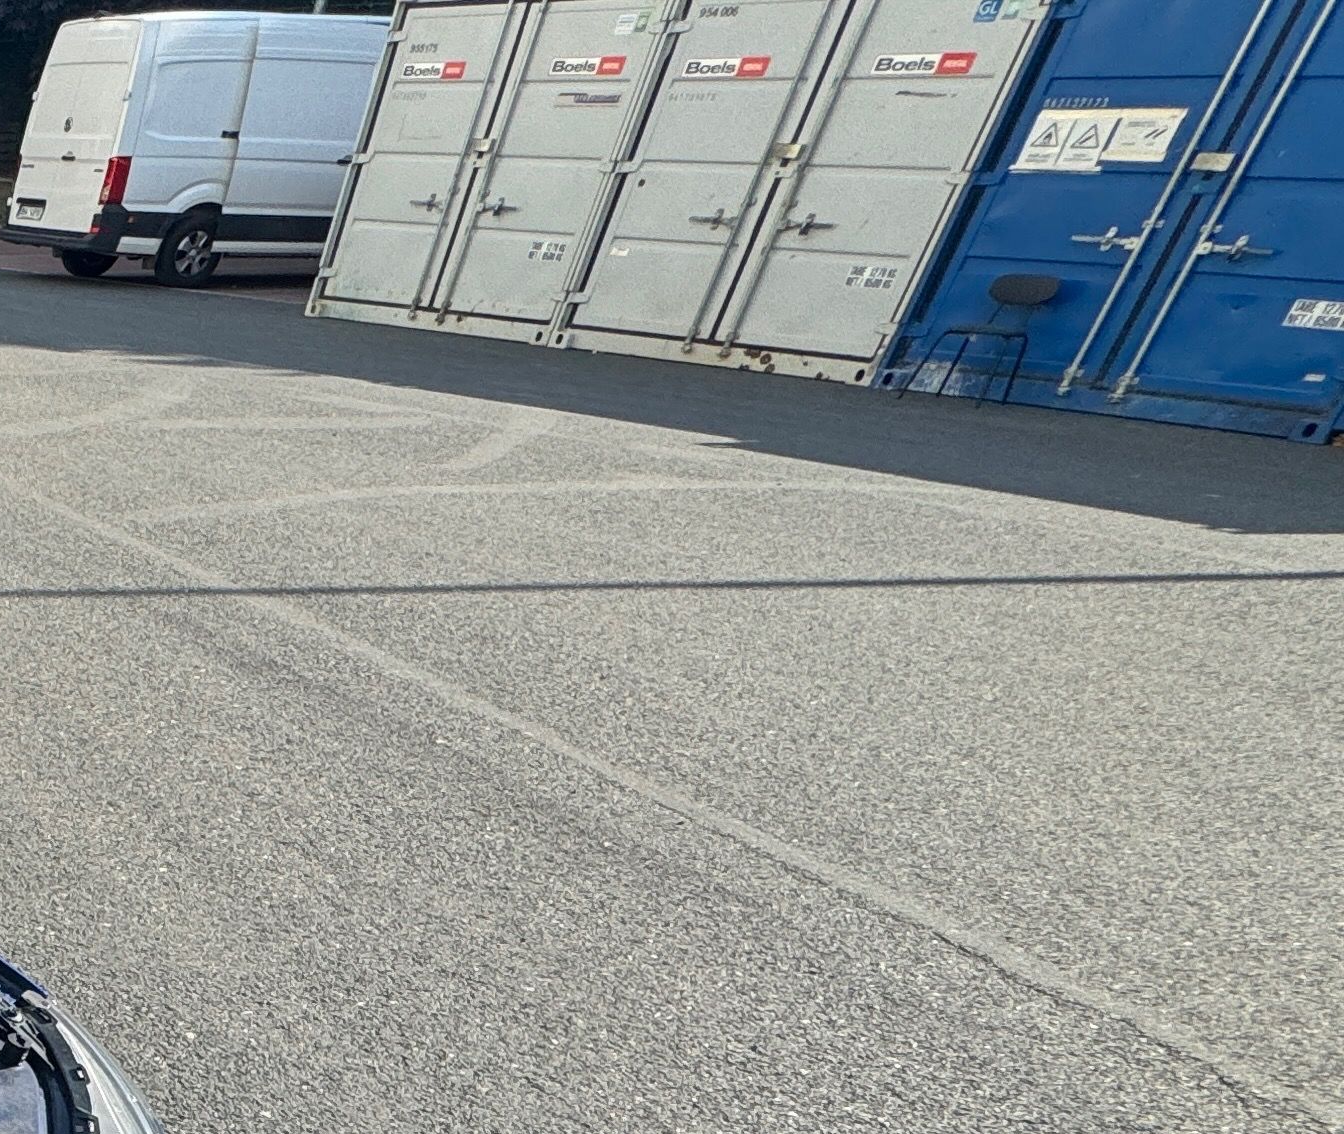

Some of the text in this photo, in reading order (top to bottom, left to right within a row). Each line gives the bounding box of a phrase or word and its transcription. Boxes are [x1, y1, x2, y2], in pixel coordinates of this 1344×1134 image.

[978, 1, 999, 16] GL
[403, 66, 440, 76] Boels
[552, 60, 596, 72] Boels
[685, 61, 736, 74] Boels
[874, 58, 936, 72] Boels
